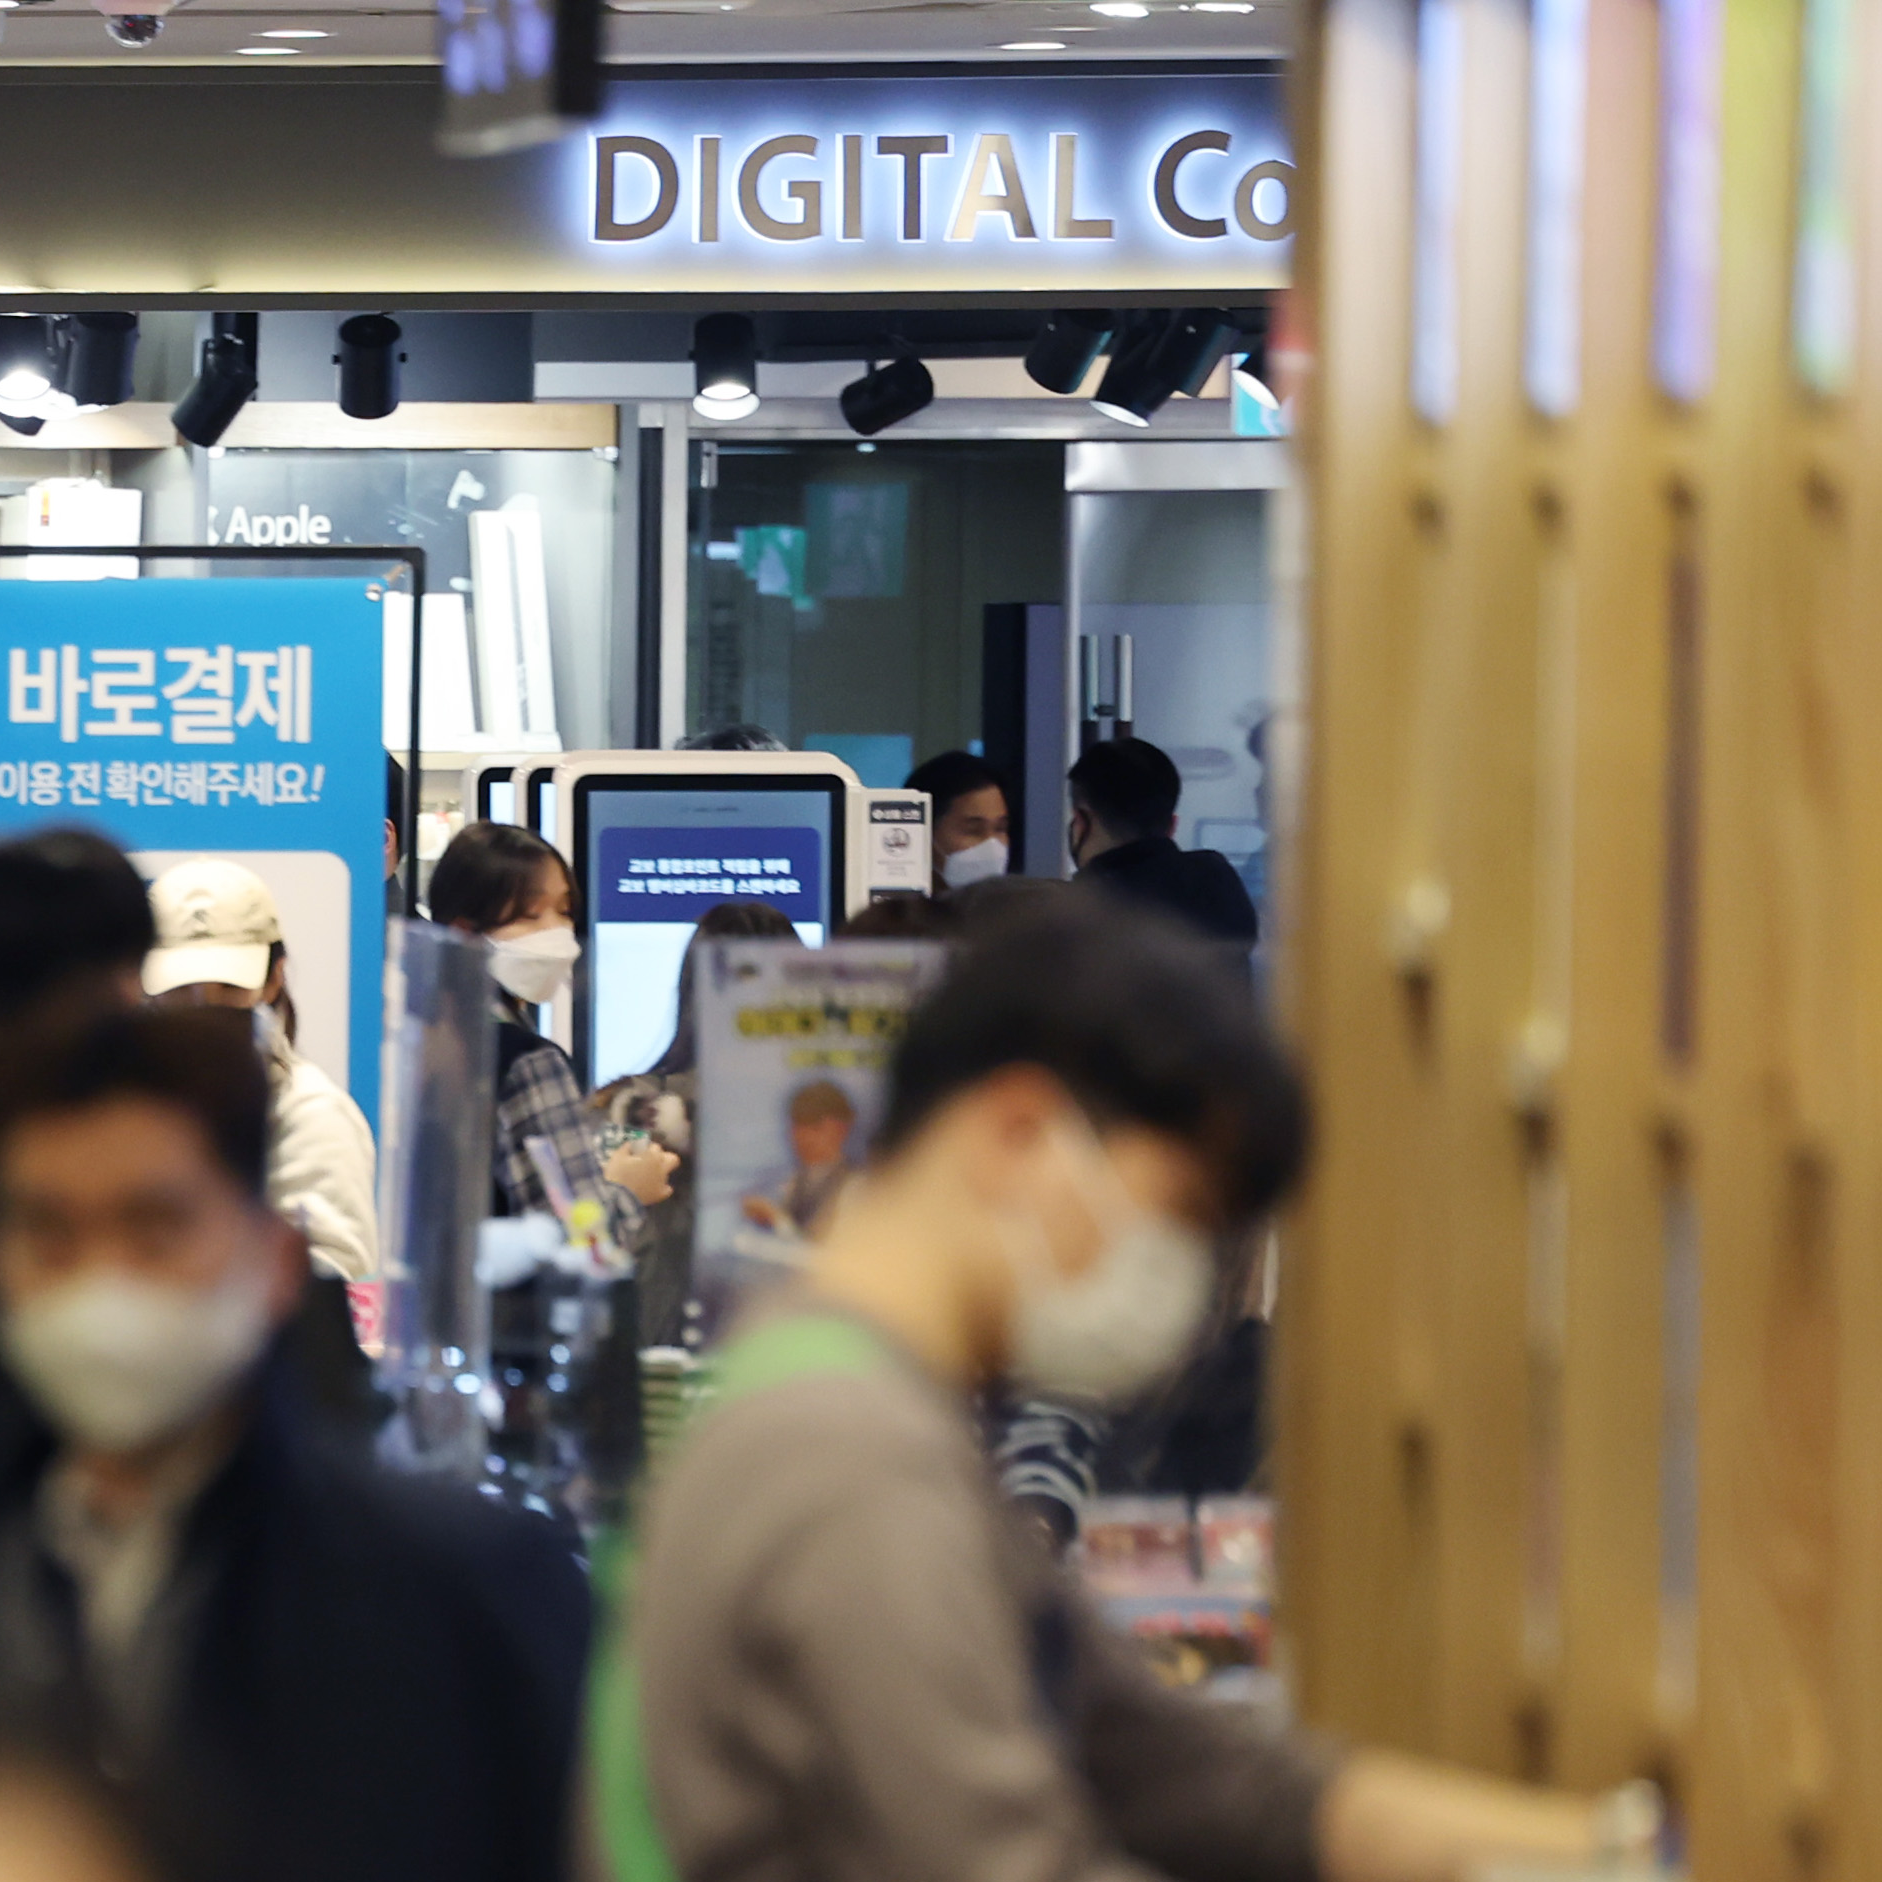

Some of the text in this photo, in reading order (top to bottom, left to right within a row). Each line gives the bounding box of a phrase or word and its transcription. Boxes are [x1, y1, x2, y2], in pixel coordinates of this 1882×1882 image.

[591, 133, 1115, 243] DIGITAL
[223, 504, 332, 546] Apple
[8, 644, 313, 744] 바로결제
[66, 760, 102, 806] 전
[105, 760, 327, 806] 확인해주세요!
